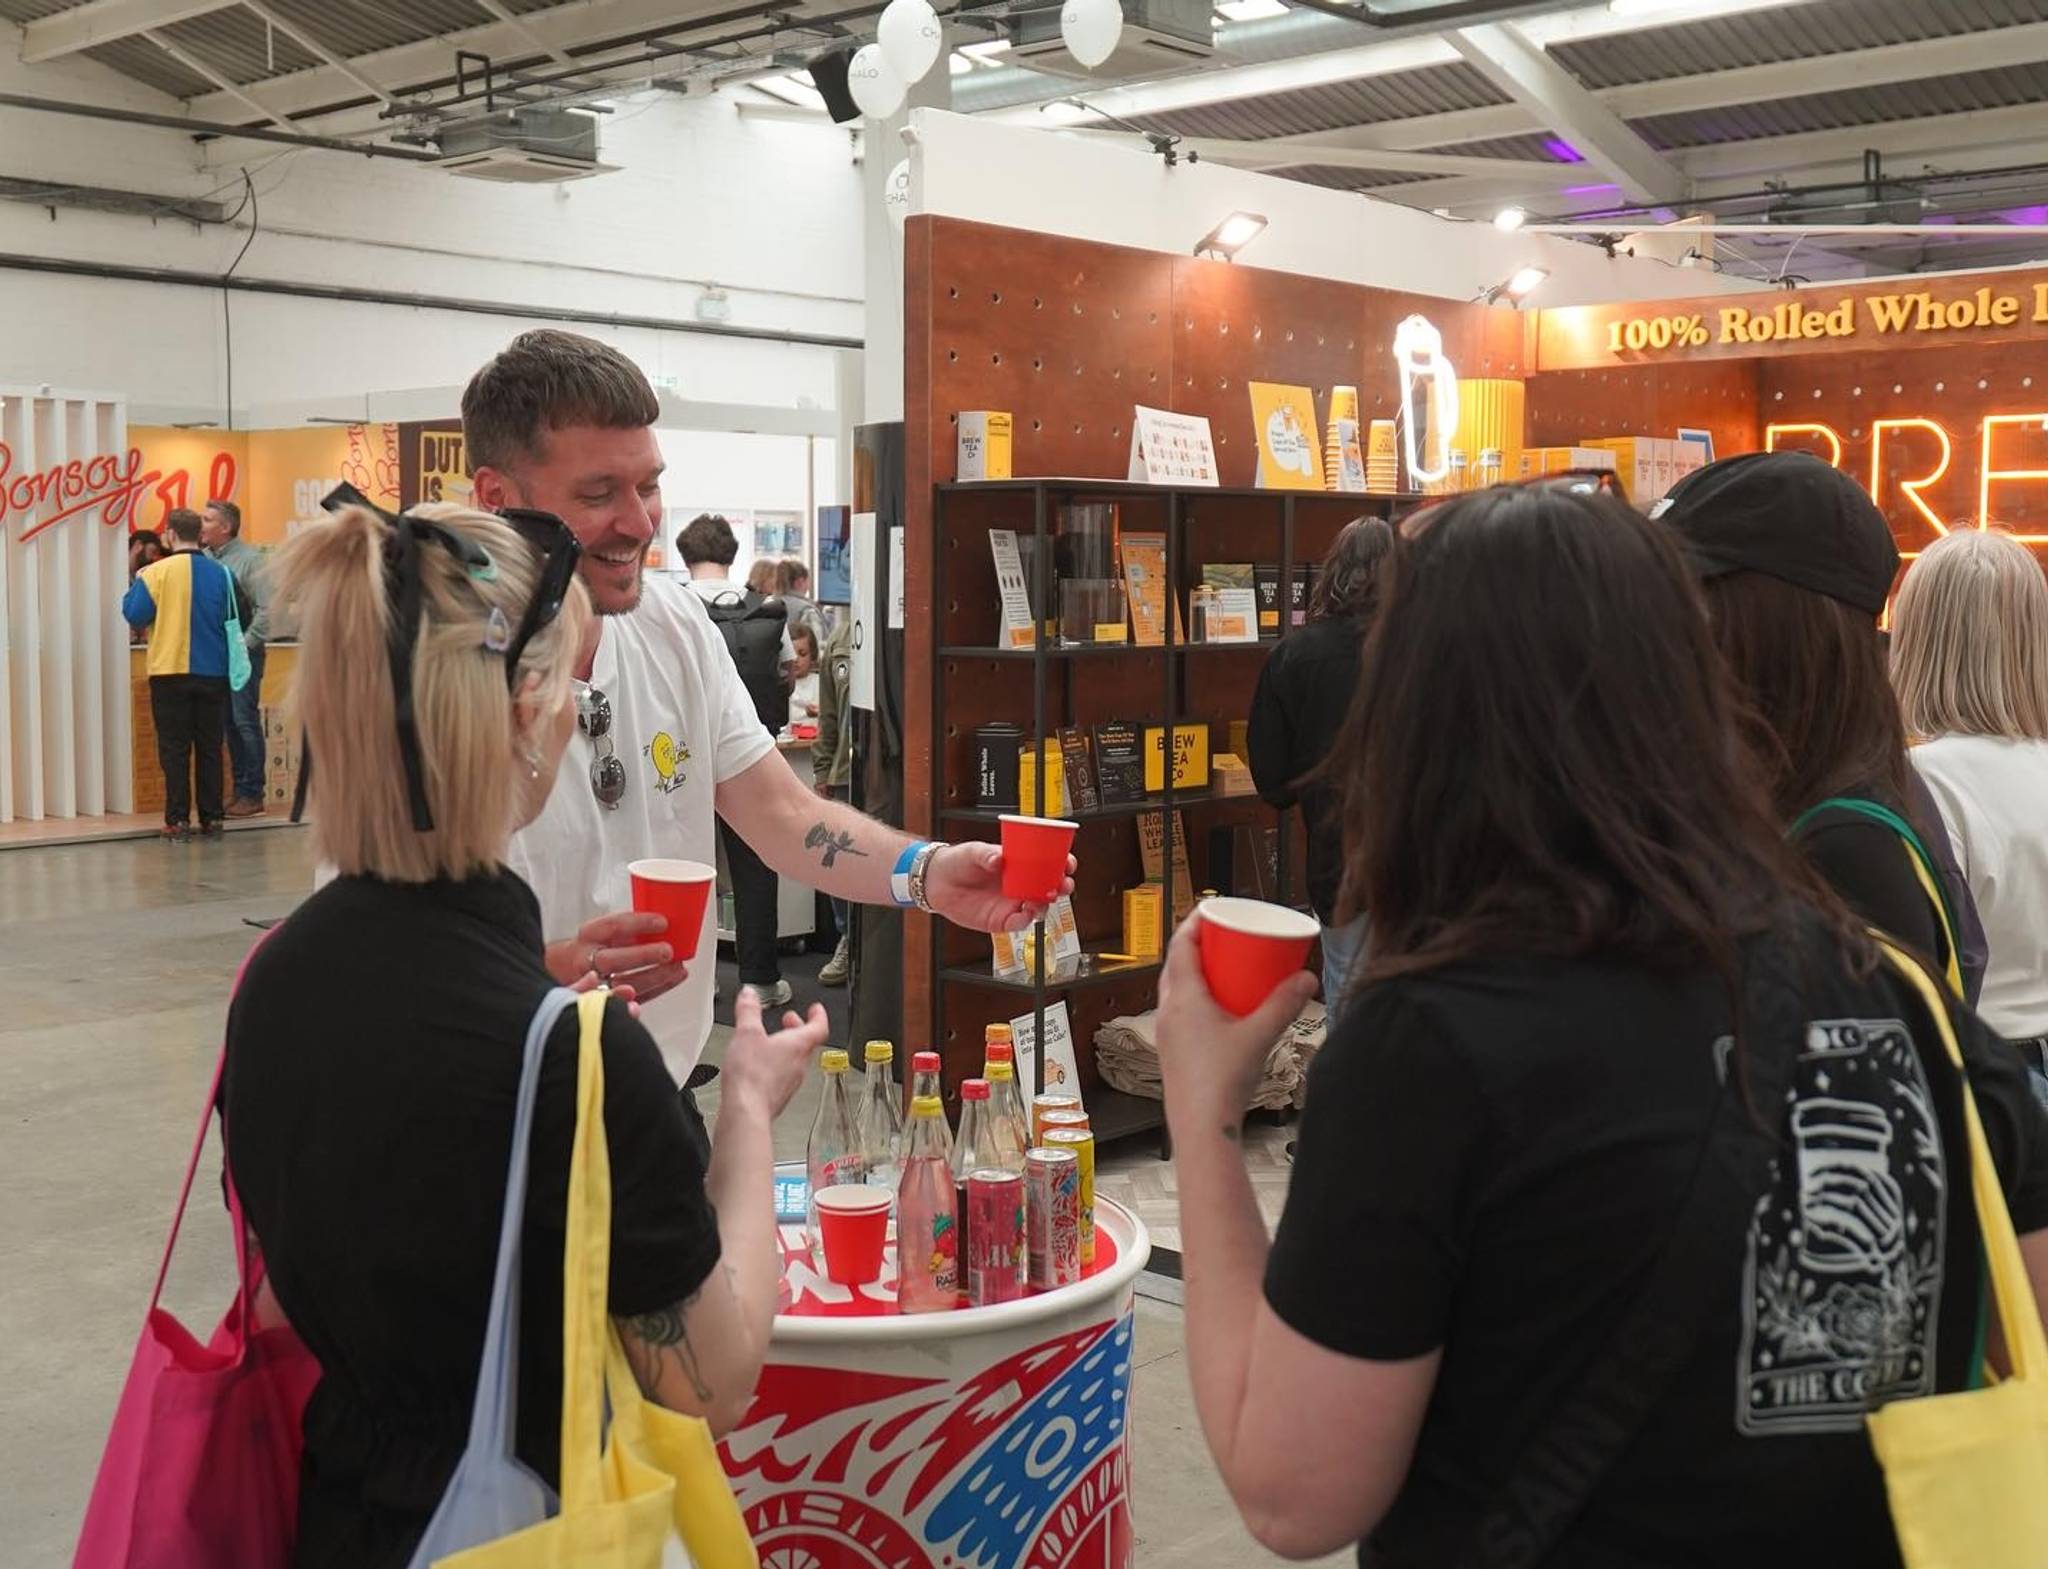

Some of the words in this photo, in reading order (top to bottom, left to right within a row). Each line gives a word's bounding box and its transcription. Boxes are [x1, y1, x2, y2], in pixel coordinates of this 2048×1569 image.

[1607, 314, 1708, 350] 100%
[1718, 299, 1855, 343] Rolled
[1865, 287, 2020, 333] Whole
[1770, 1371, 1829, 1405] THE
